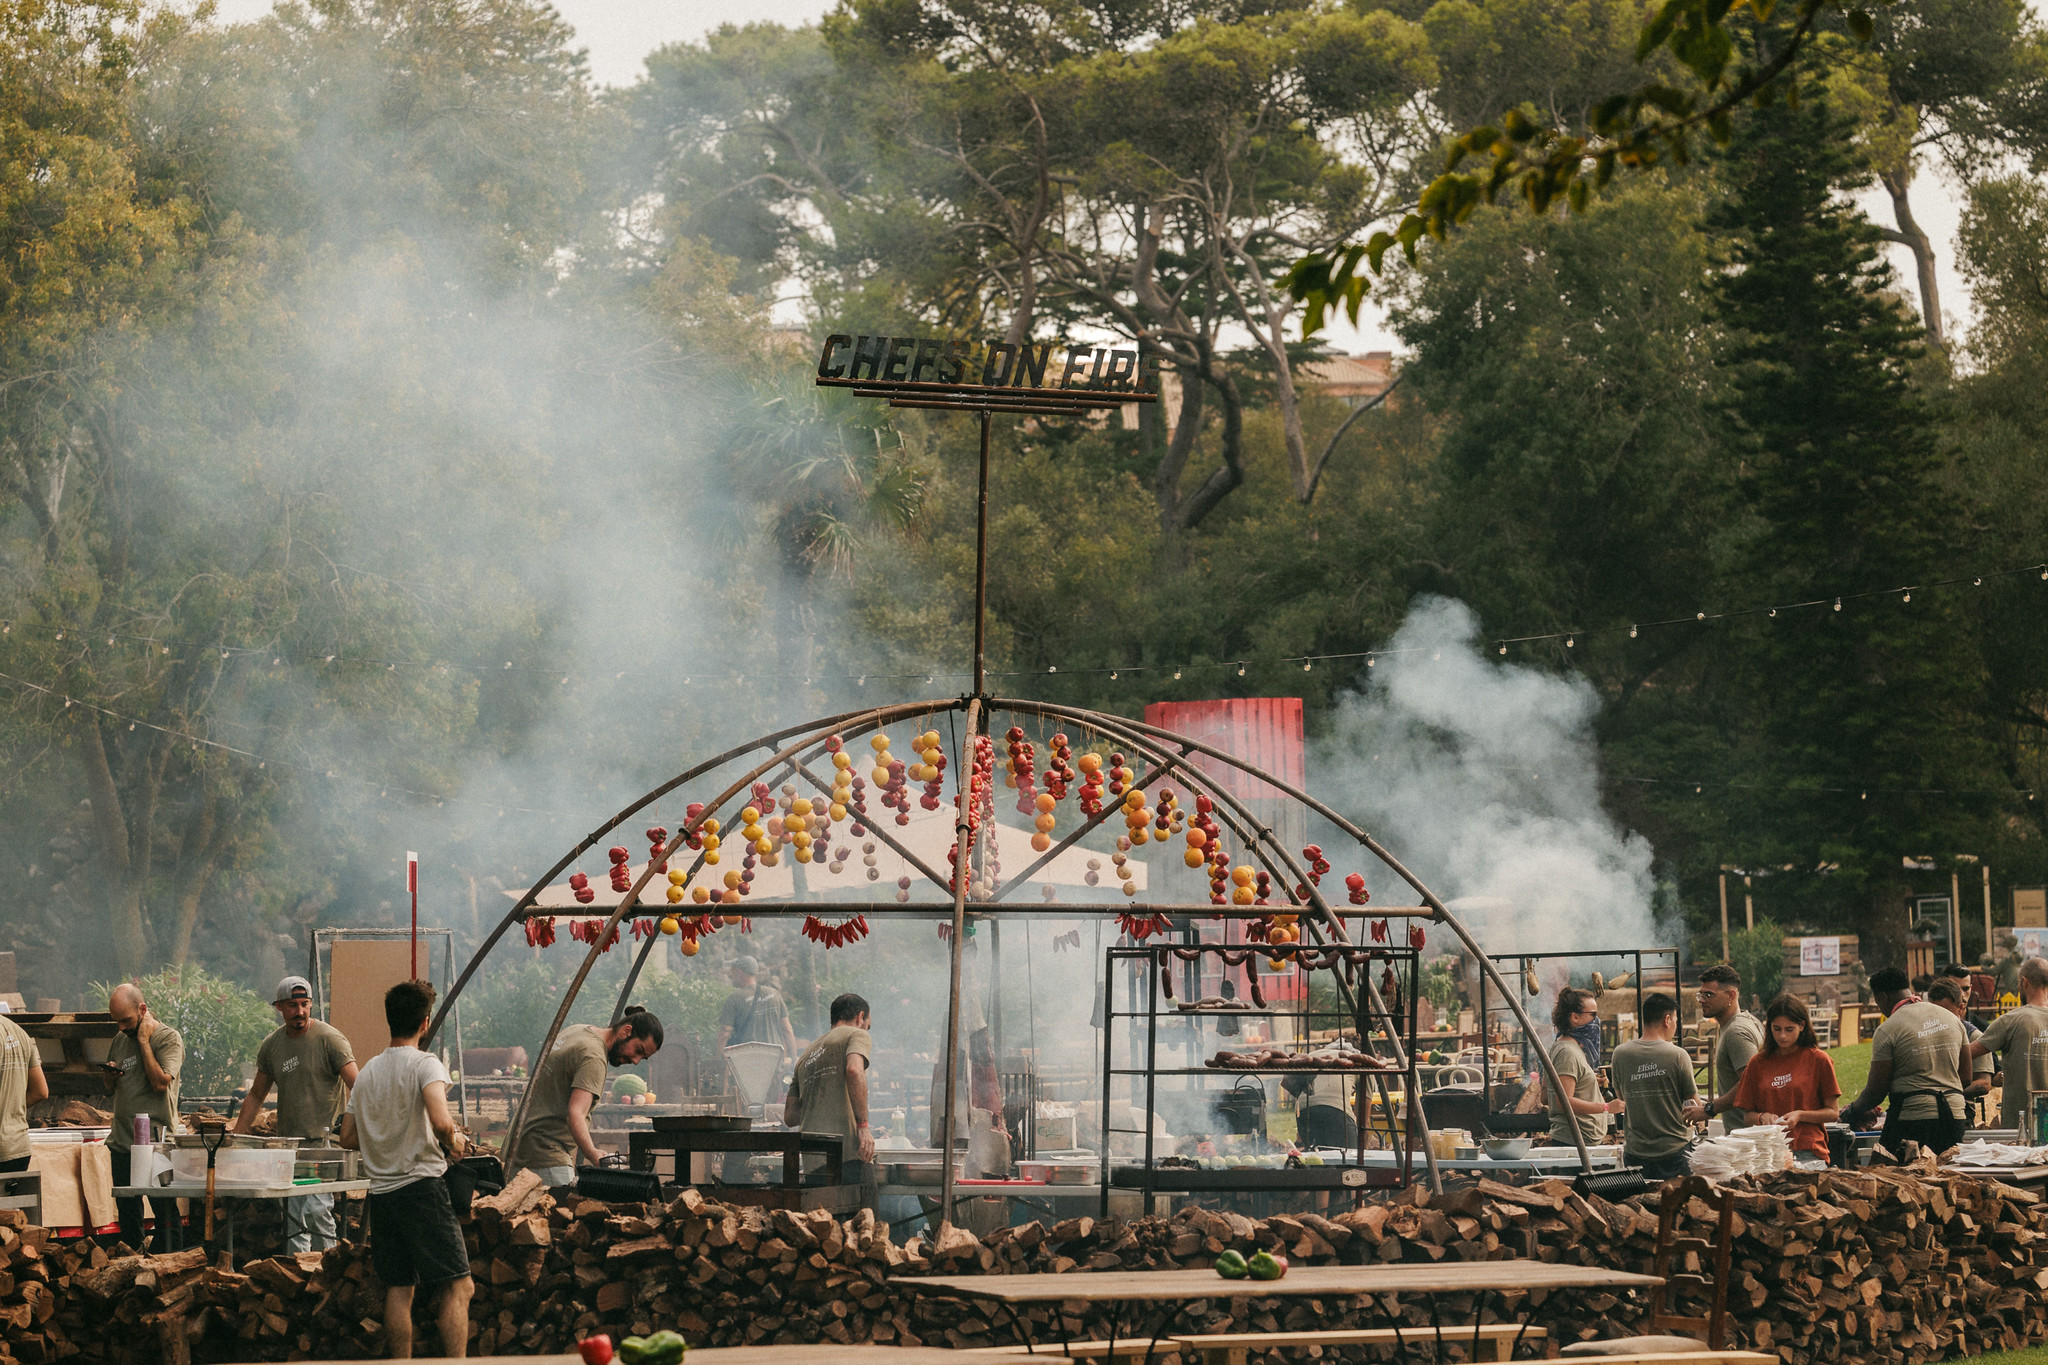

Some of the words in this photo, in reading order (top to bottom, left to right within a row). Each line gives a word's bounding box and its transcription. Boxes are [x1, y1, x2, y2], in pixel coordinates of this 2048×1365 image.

[817, 334, 971, 384] CHEFS
[981, 343, 1051, 388] ON
[1060, 347, 1160, 394] FIRE
[1630, 1069, 1666, 1082] Bernardes
